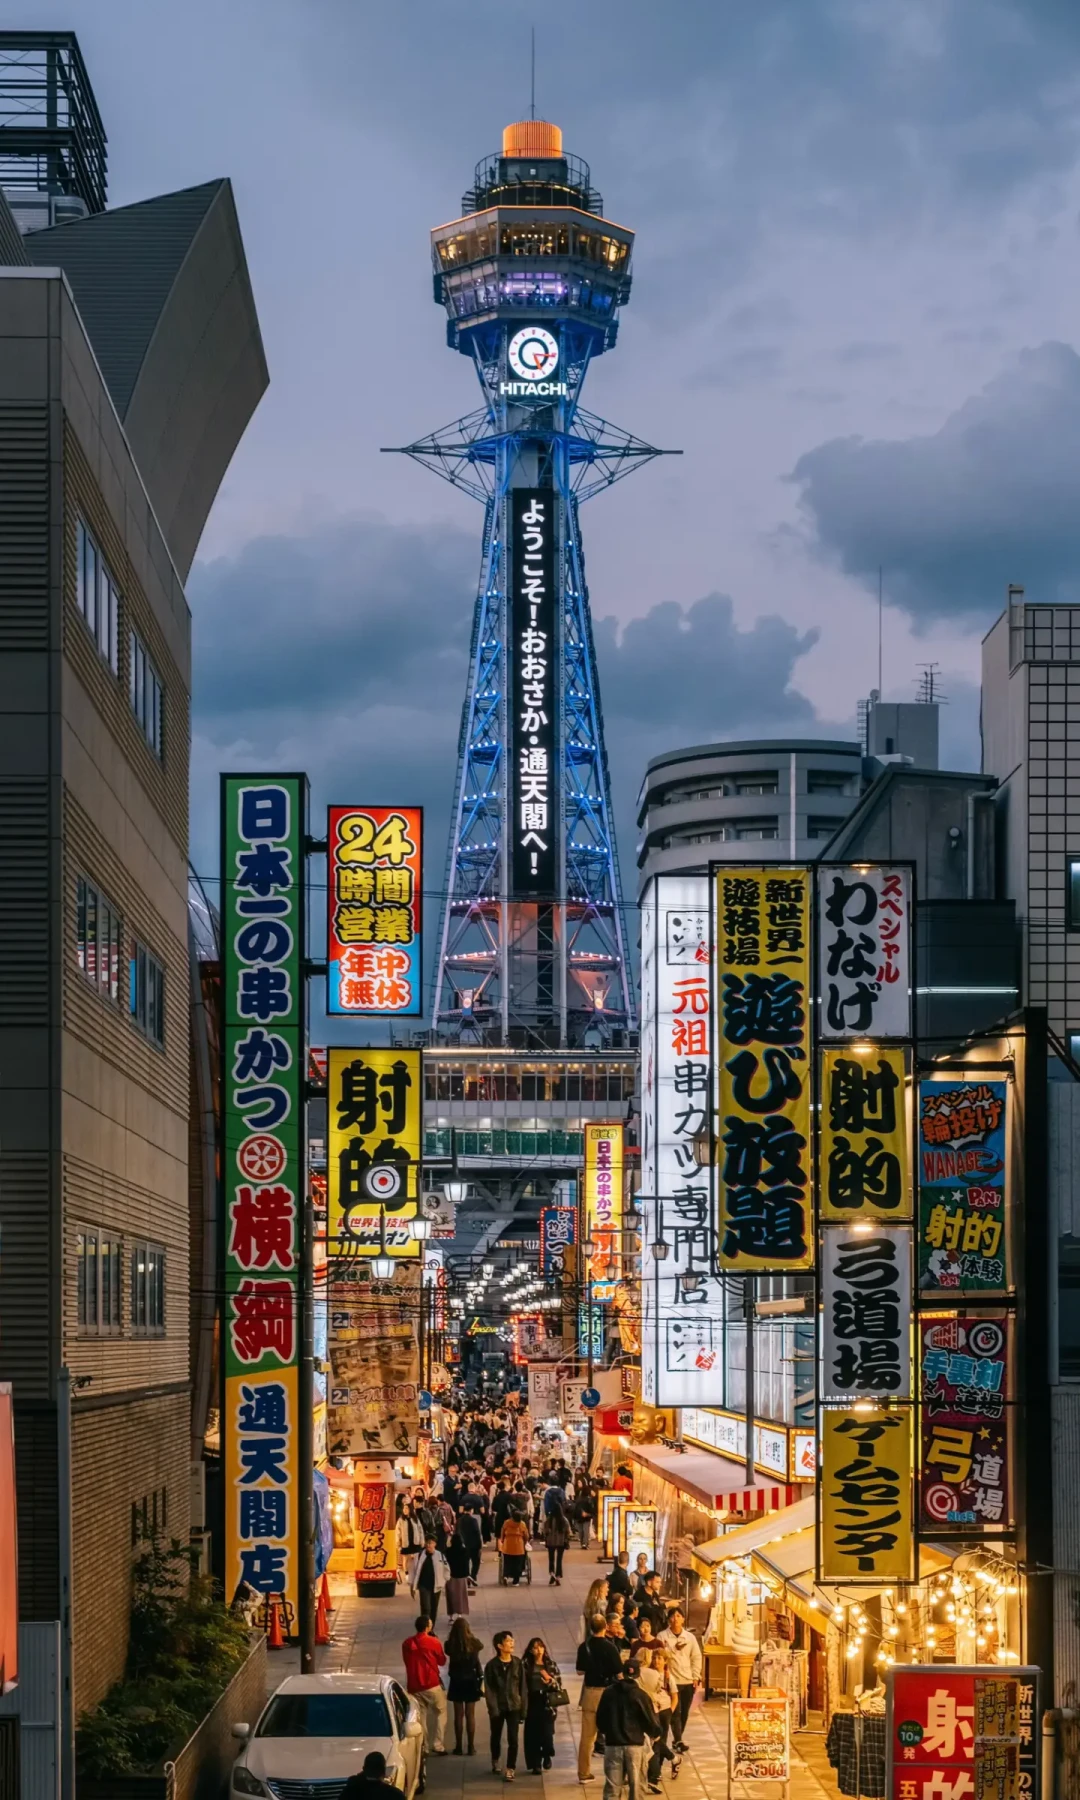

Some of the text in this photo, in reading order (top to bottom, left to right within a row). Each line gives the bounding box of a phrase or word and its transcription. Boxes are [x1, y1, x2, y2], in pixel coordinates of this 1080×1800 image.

[500, 382, 567, 395] HITACHI
[520, 499, 549, 875] ようこそ！おおさか・通天閣へ！
[334, 812, 415, 866] 24
[334, 866, 415, 905] 時間
[333, 904, 415, 945] 営業
[723, 878, 760, 966] 遊技場
[765, 879, 805, 966] 新世界一
[876, 875, 903, 983] スペシャル
[232, 785, 294, 1133] 日本一の串かつ
[339, 947, 411, 979] 年中
[825, 876, 882, 1031] わなげ
[339, 977, 411, 1010] 無休
[721, 972, 808, 1260] 遊び放題
[922, 1085, 993, 1112] スペシャル
[922, 1099, 1003, 1144] 輪投げ
[336, 1059, 412, 1212] 射的
[828, 1058, 902, 1209] 射的
[923, 1151, 985, 1182] WANAGE
[967, 1187, 1001, 1208] PAN!
[925, 1204, 1003, 1258] 射的
[228, 1183, 298, 1364] 横綱
[959, 1254, 1004, 1283] 体験
[832, 1238, 902, 1390] 弓道場
[922, 1350, 1004, 1392] 手裏剣
[954, 1387, 1004, 1418] 道場
[926, 1426, 973, 1483] 弓
[235, 1382, 290, 1593] 通天閣店
[829, 1416, 904, 1572] ゲームセンター
[972, 1453, 1004, 1520] 道場
[361, 1487, 387, 1570] 射的体験
[946, 1510, 977, 1523] NICE!
